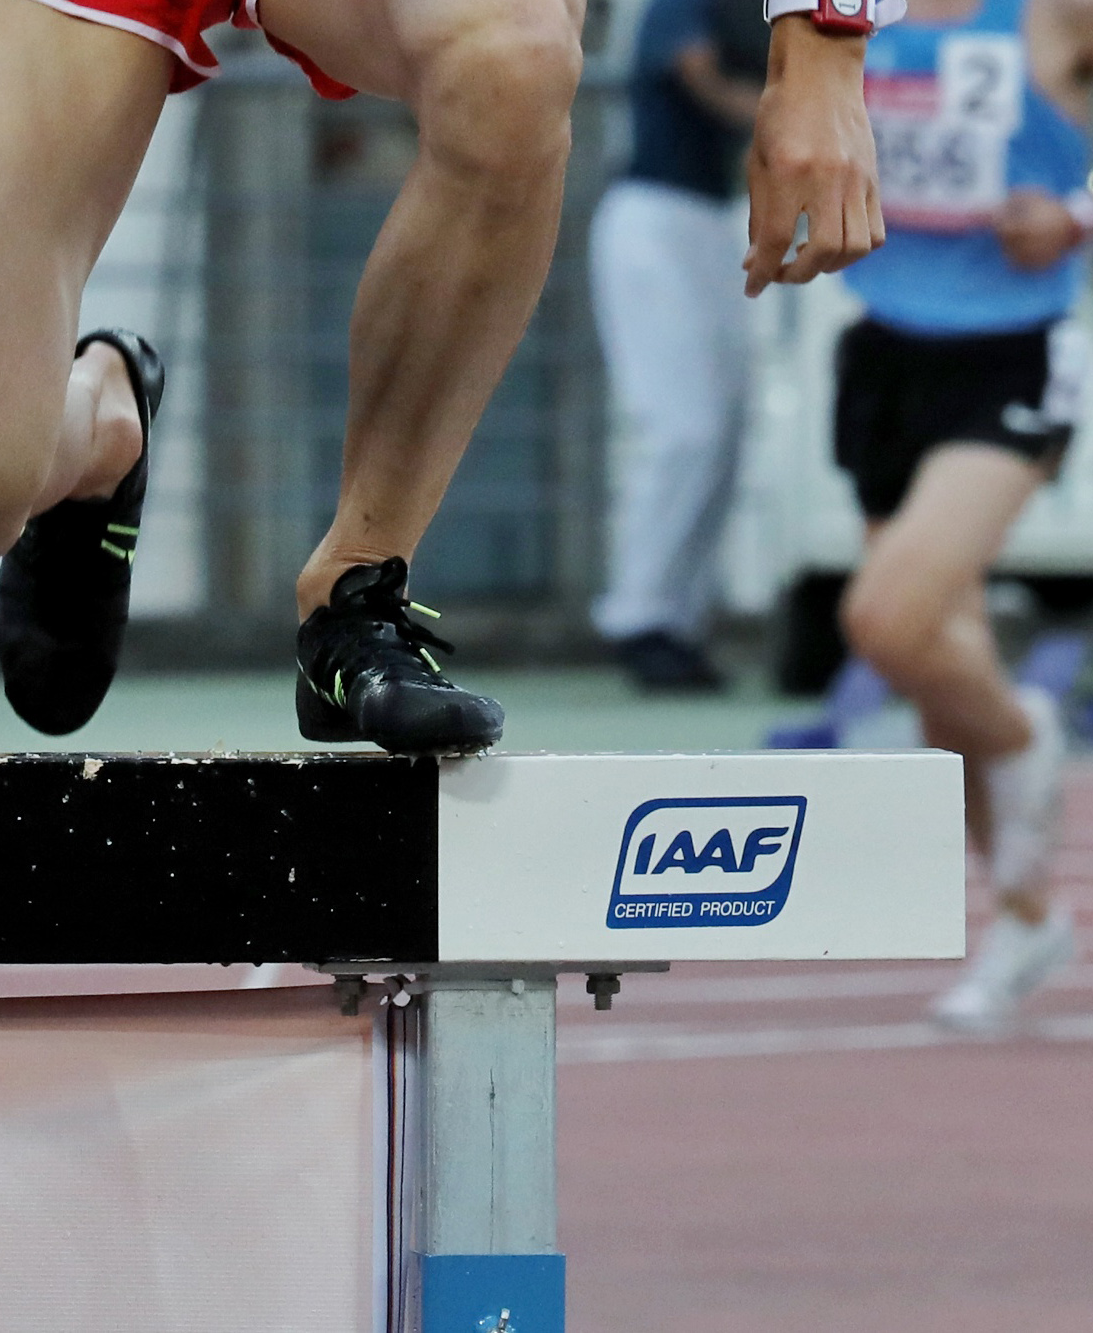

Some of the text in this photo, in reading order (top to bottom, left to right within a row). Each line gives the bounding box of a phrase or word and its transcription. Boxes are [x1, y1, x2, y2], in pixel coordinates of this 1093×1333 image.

[633, 827, 790, 875] IAAF
[614, 900, 775, 918] CERTIFIED PRODUCT
